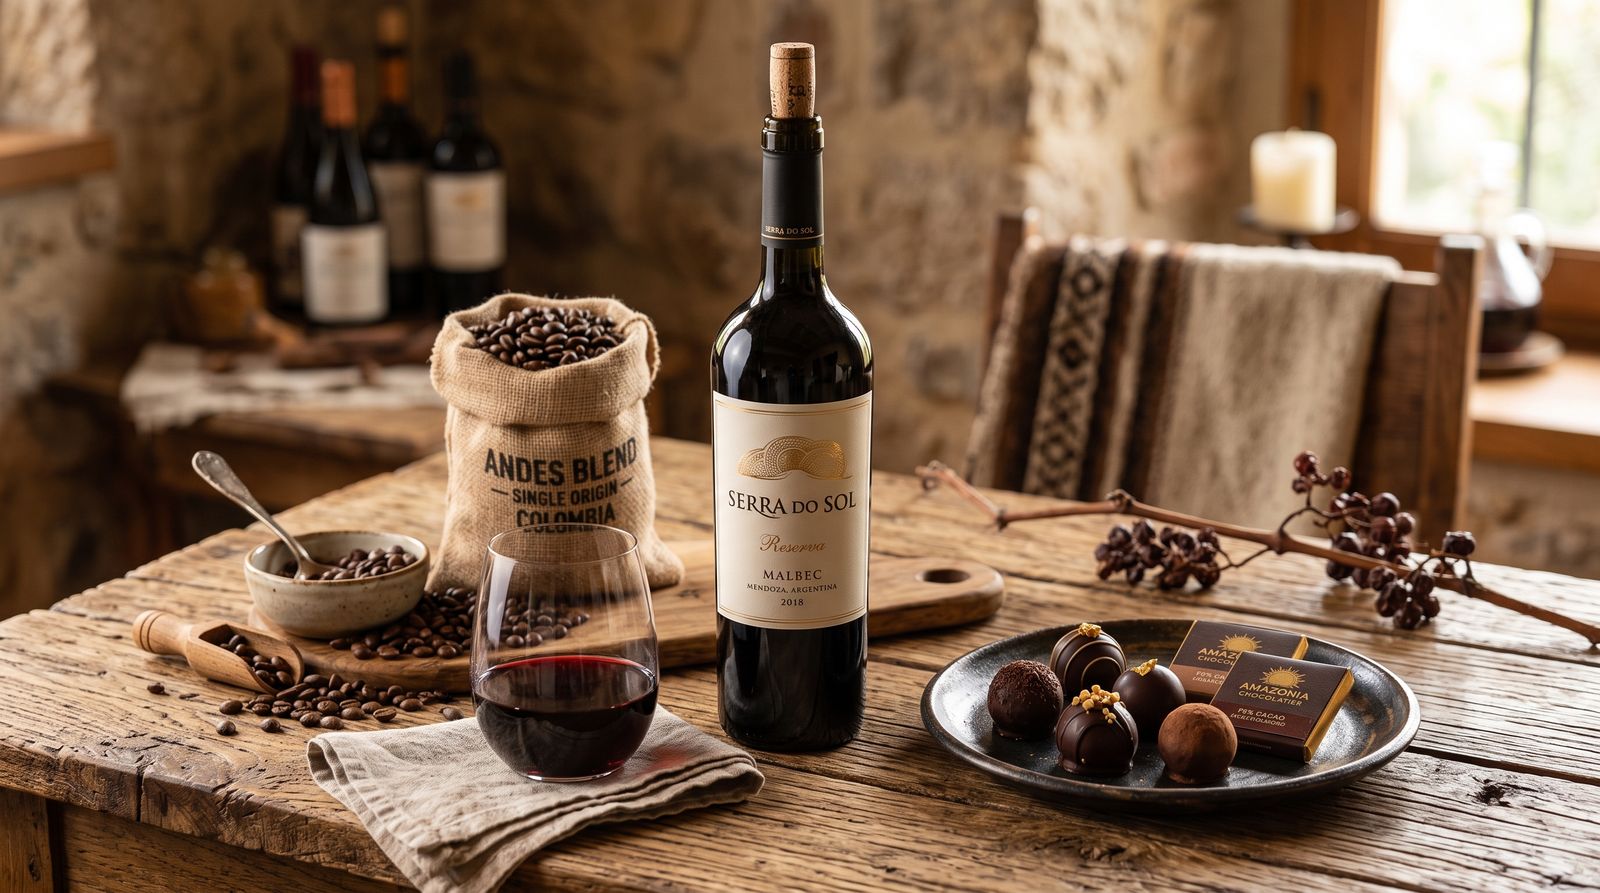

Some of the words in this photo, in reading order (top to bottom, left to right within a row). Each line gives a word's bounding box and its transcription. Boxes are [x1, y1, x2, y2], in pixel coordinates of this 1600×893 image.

[786, 227, 799, 235] DO
[800, 226, 815, 234] SOL
[485, 448, 565, 486] ANDES
[573, 437, 636, 484] BLEND
[513, 489, 566, 506] SINGLE
[570, 479, 618, 505] ORIGIN
[728, 489, 788, 519] SERRA
[792, 500, 819, 514] DO
[824, 491, 857, 513] SOL
[516, 502, 616, 533] COLOMBIA
[760, 533, 826, 553] Reserva
[763, 569, 823, 581] MALBEC
[747, 583, 789, 594] MENDOZA,
[791, 583, 837, 593] ARGENTINA
[781, 598, 804, 606] 2018
[1238, 690, 1303, 706] CHOCOLATIER
[1239, 682, 1309, 700] AMAZONIA
[1255, 711, 1286, 721] CACAO
